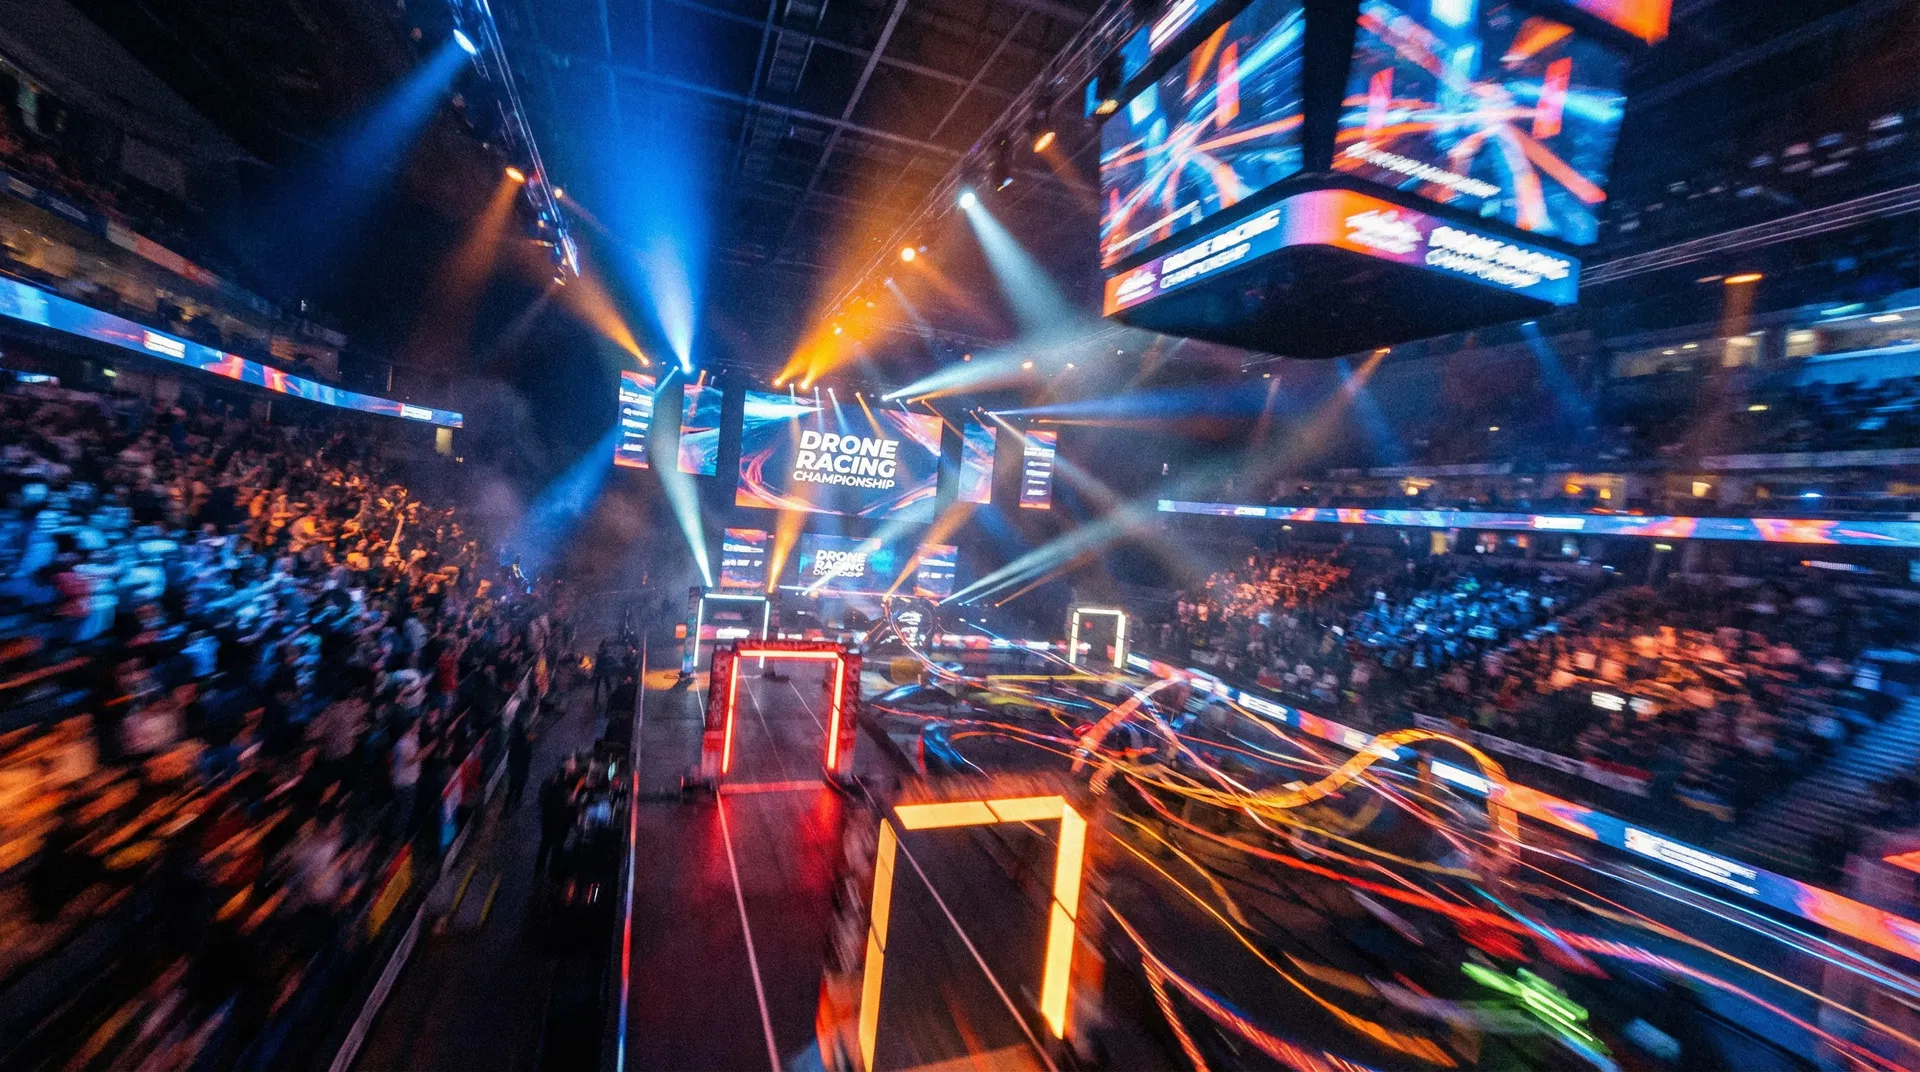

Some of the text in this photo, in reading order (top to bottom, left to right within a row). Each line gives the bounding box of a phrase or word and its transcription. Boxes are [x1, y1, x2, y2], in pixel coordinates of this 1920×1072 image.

[799, 430, 899, 459] DRONE
[795, 450, 897, 478] RACING
[792, 470, 895, 489] CHAMPIONSHIP
[815, 549, 867, 563] DRONE
